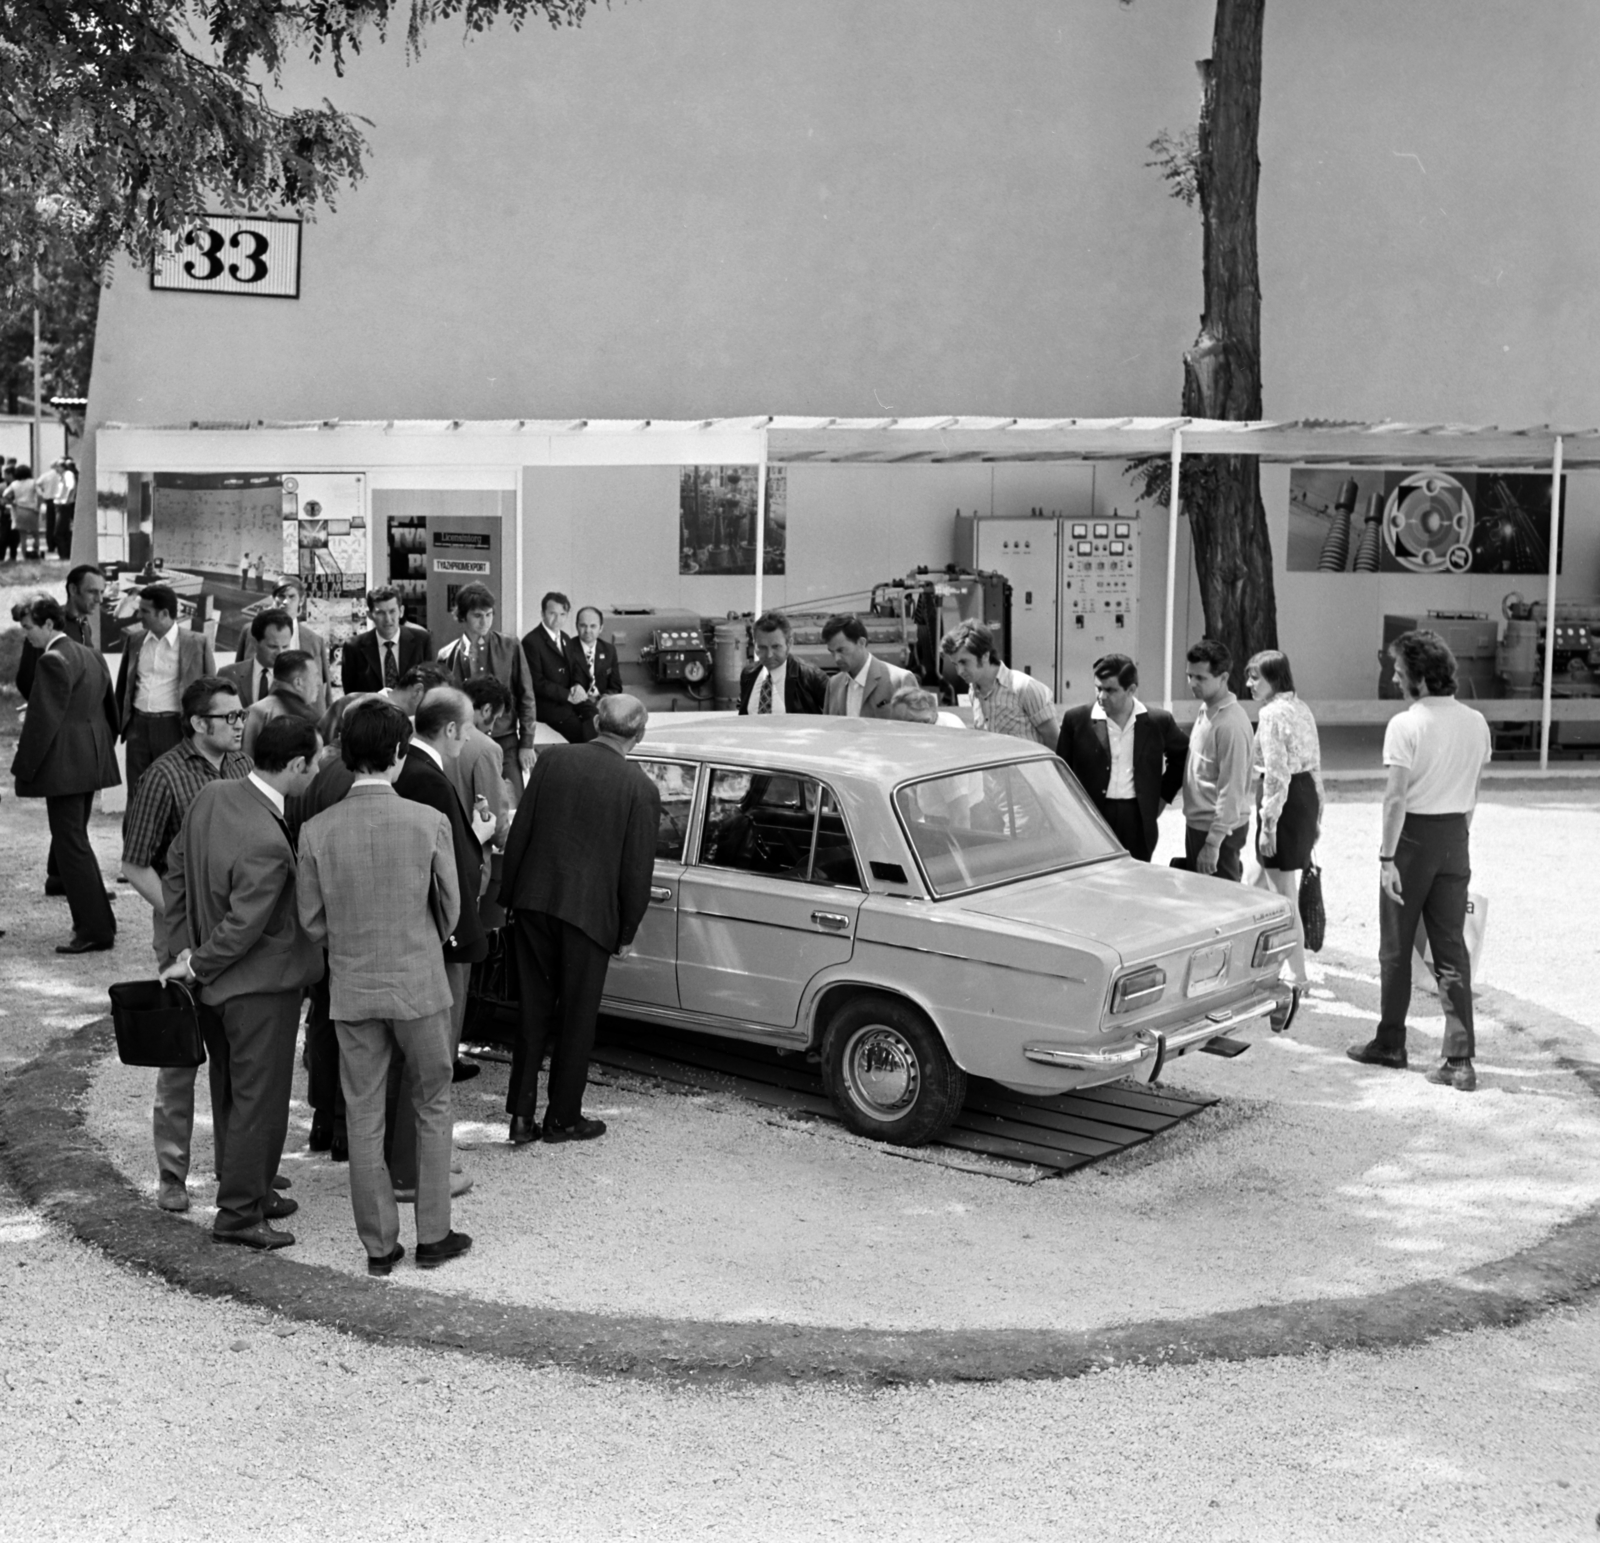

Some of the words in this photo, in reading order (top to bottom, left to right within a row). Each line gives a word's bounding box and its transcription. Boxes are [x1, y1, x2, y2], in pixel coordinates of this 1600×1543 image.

[184, 228, 269, 282] 33
[436, 560, 486, 572] TYAZHPROMEXPORT
[301, 574, 342, 583] TECHNO
